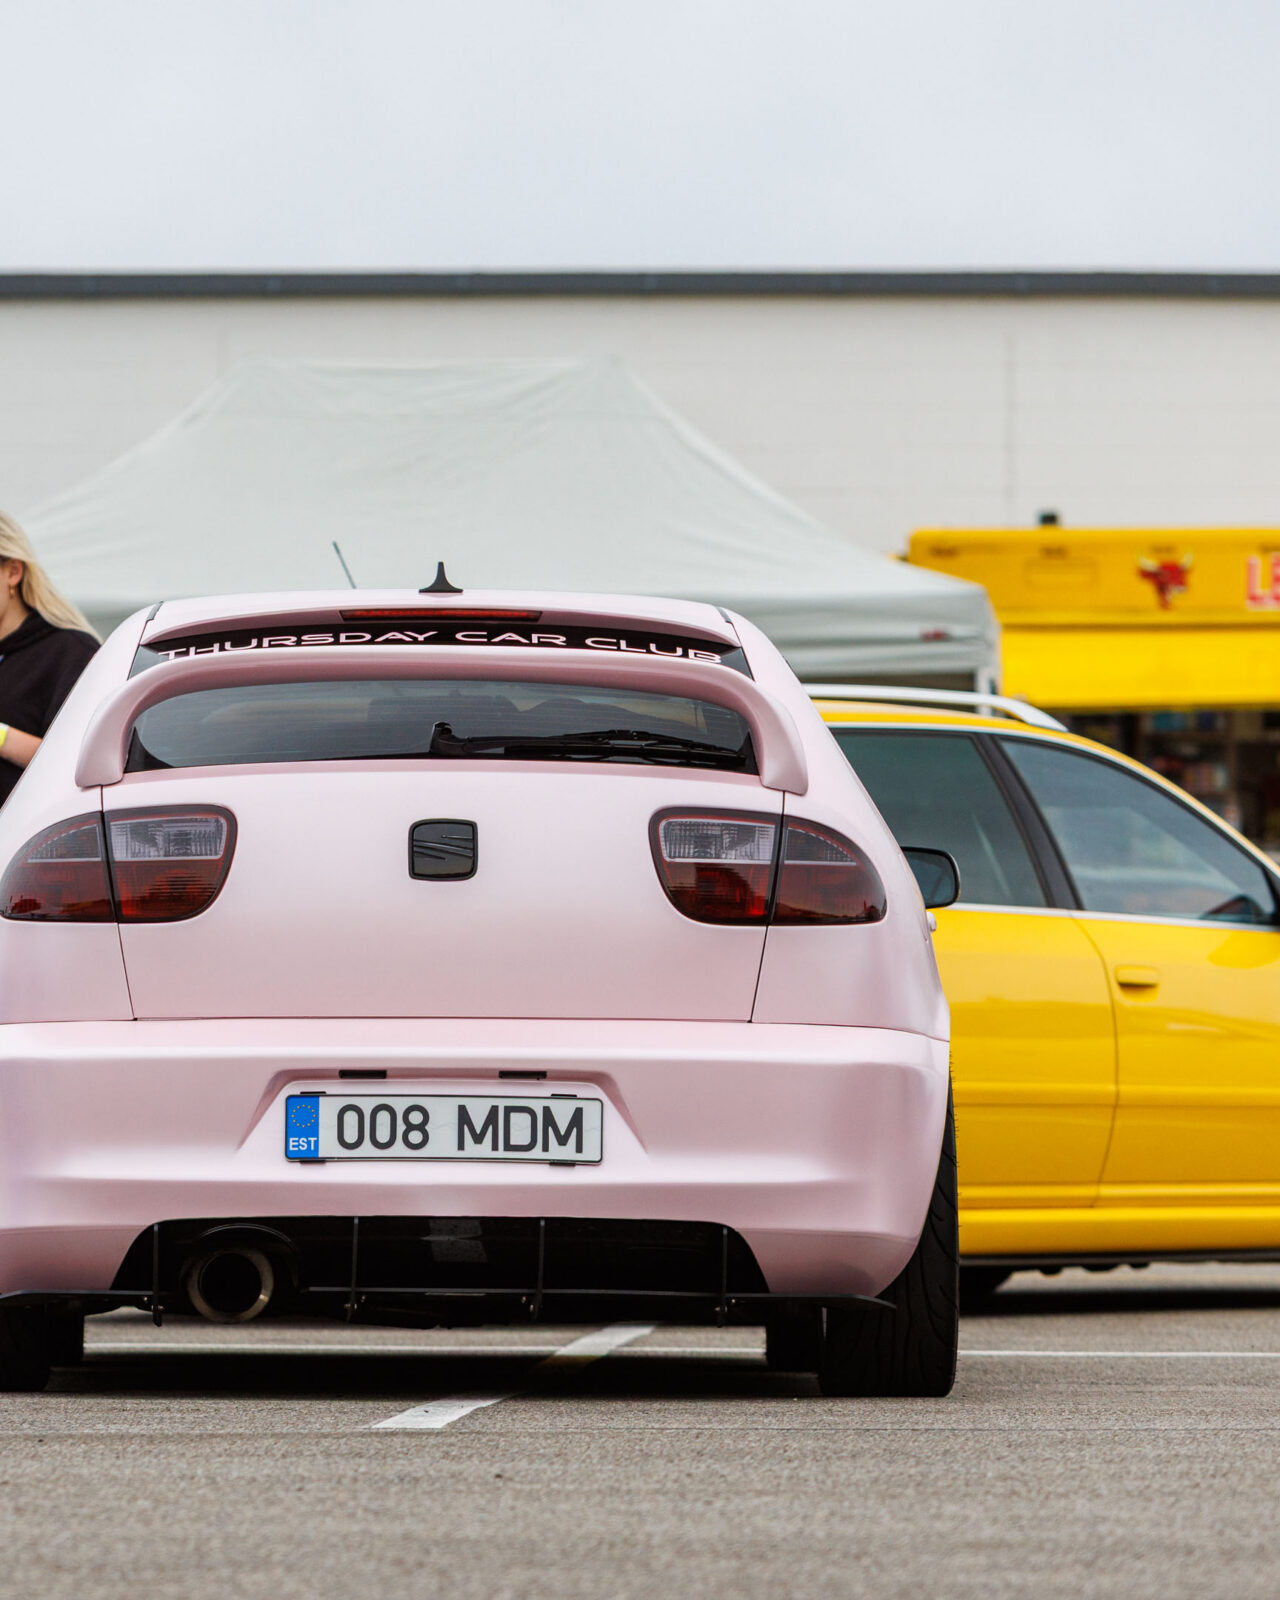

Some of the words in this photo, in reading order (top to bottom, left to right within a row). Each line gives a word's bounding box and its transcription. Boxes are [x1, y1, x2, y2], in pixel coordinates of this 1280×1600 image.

[158, 631, 438, 659] THURSDAY
[454, 631, 567, 646] CAR
[584, 637, 723, 663] CLUB
[288, 1137, 318, 1152] EST
[337, 1104, 431, 1150] 008
[457, 1104, 584, 1153] MDM
